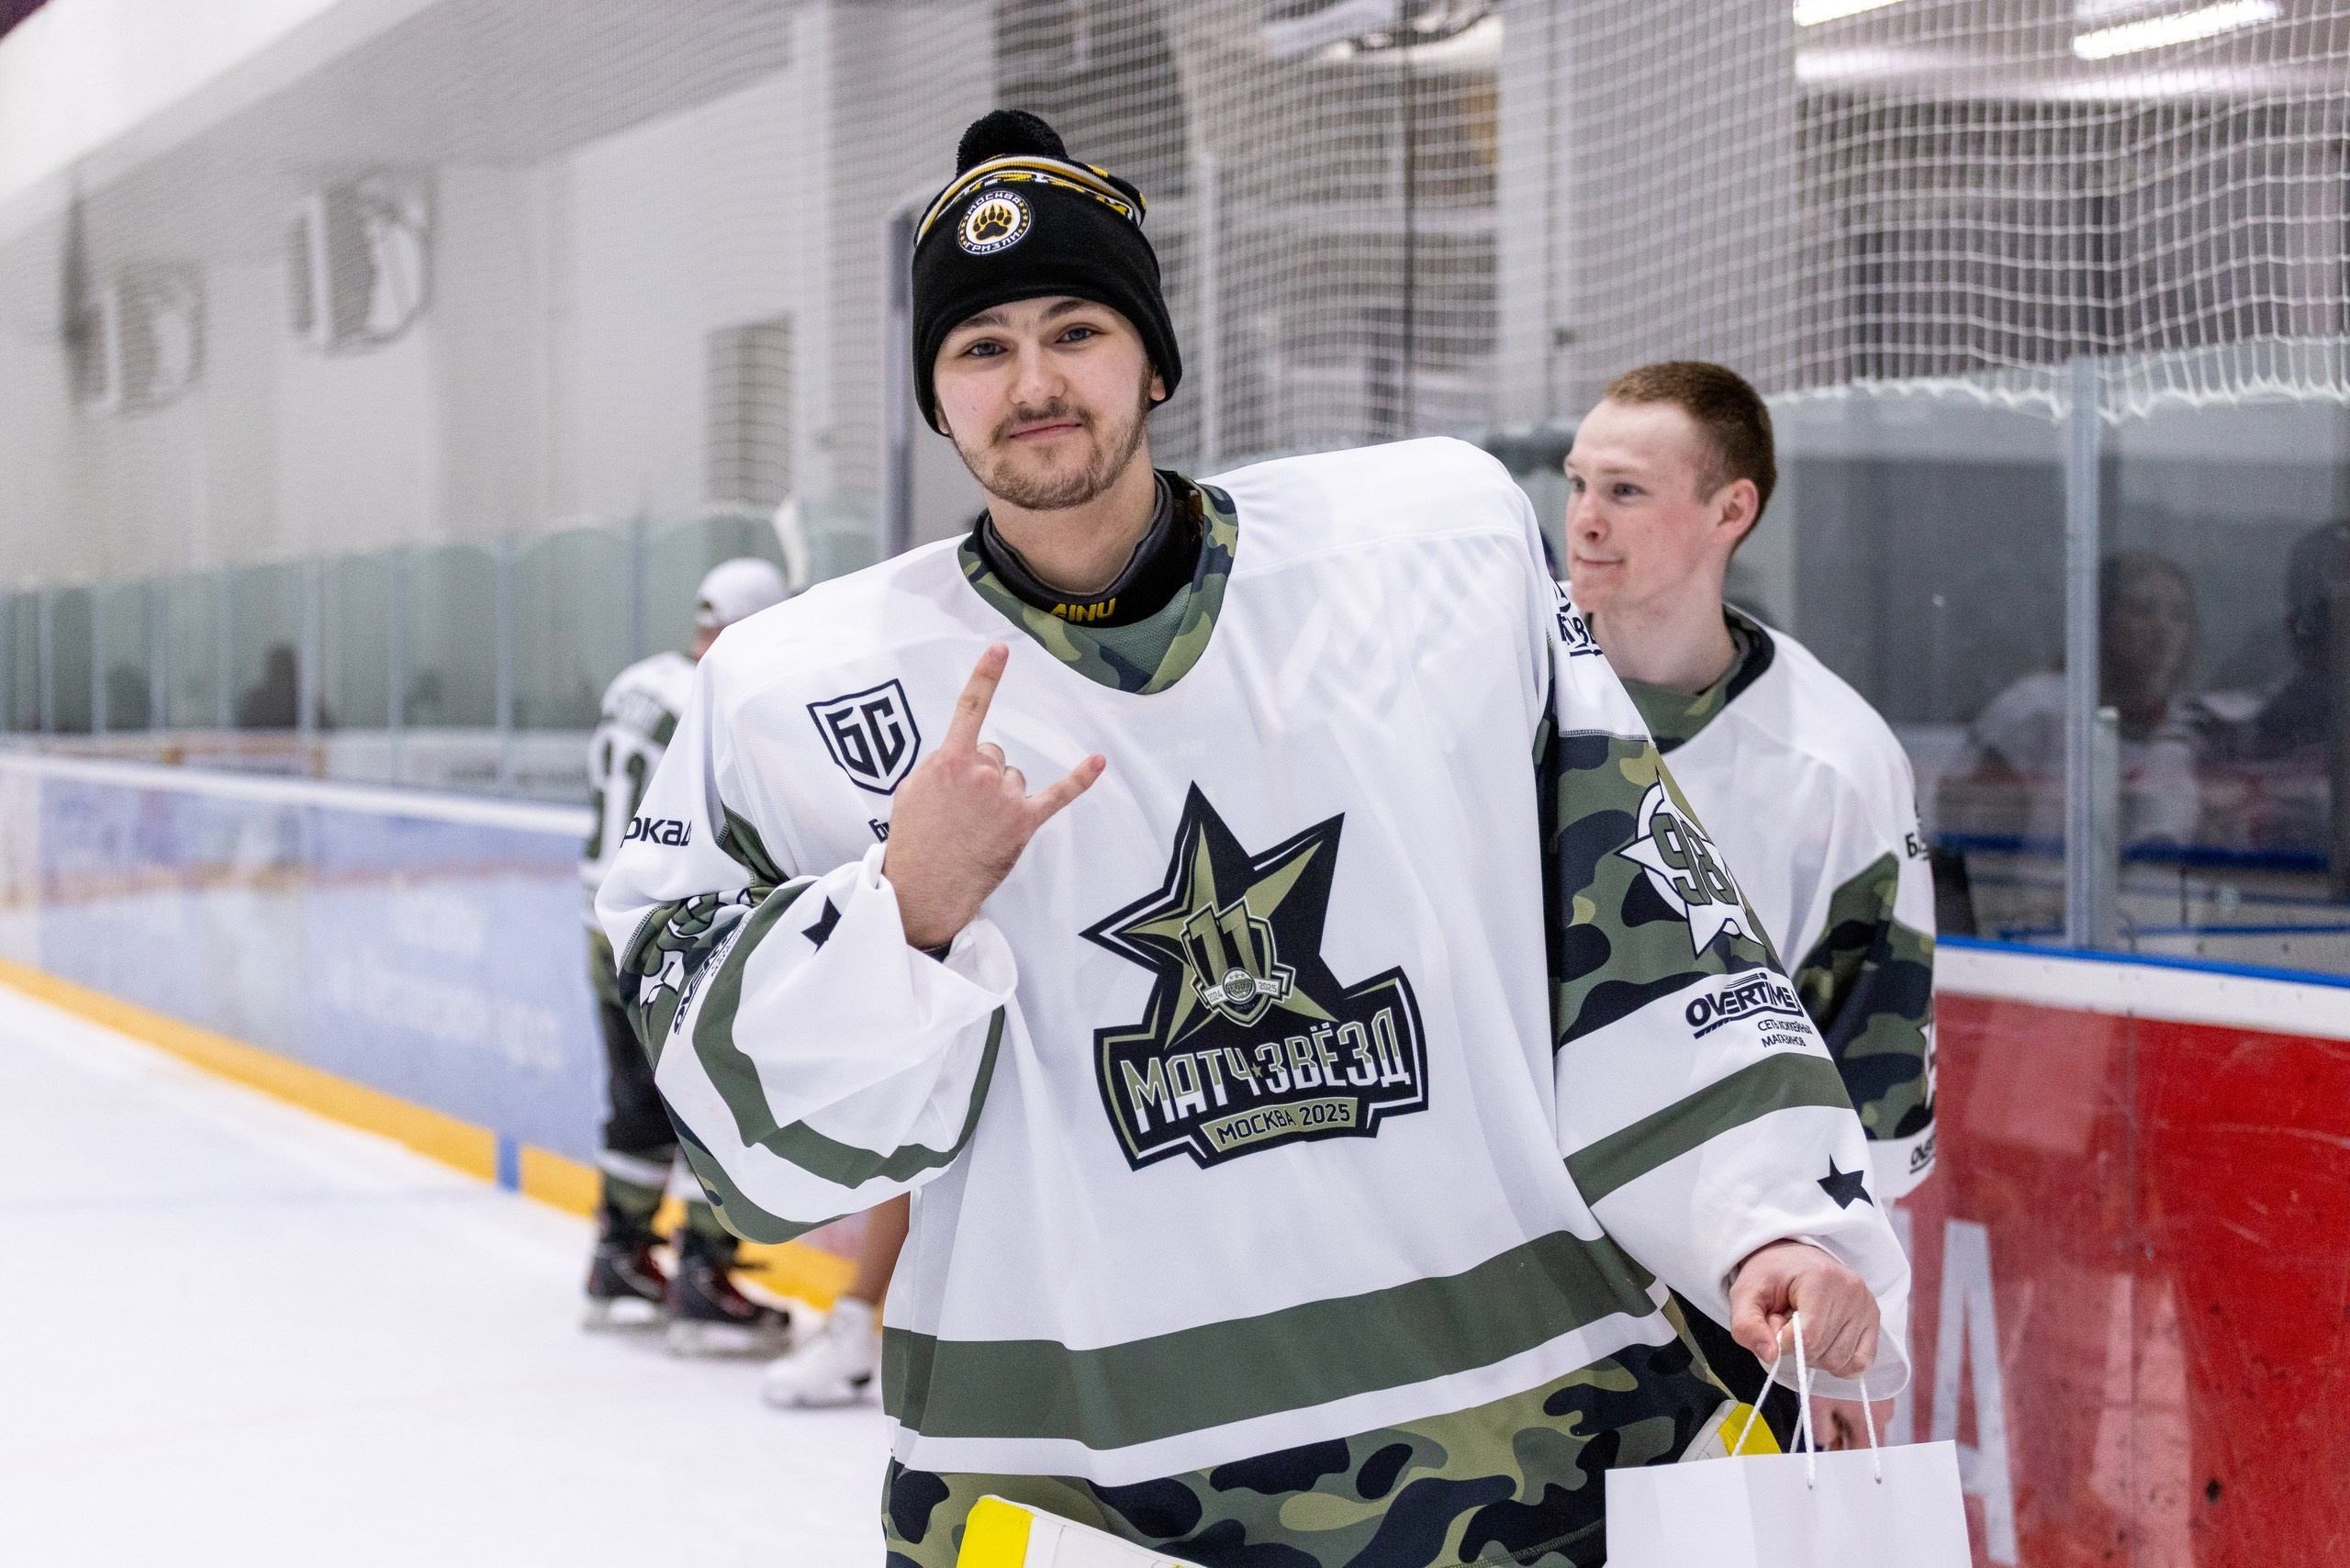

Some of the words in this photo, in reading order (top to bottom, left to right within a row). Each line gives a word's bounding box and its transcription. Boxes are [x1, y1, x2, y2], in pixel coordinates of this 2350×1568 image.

[967, 191, 1021, 215] МОСКВА
[964, 230, 1021, 252] ГРИЗЛИ
[1258, 981, 1278, 992] 2025
[1684, 980, 1798, 1027] OVERTIME
[1757, 1018, 1779, 1032] СЕТЬ
[1120, 1047, 1261, 1135] МАТЧ
[1256, 1006, 1412, 1094] ЗВЁЗД
[1215, 1107, 1297, 1146] МОСКВА
[1299, 1103, 1352, 1127] 2025
